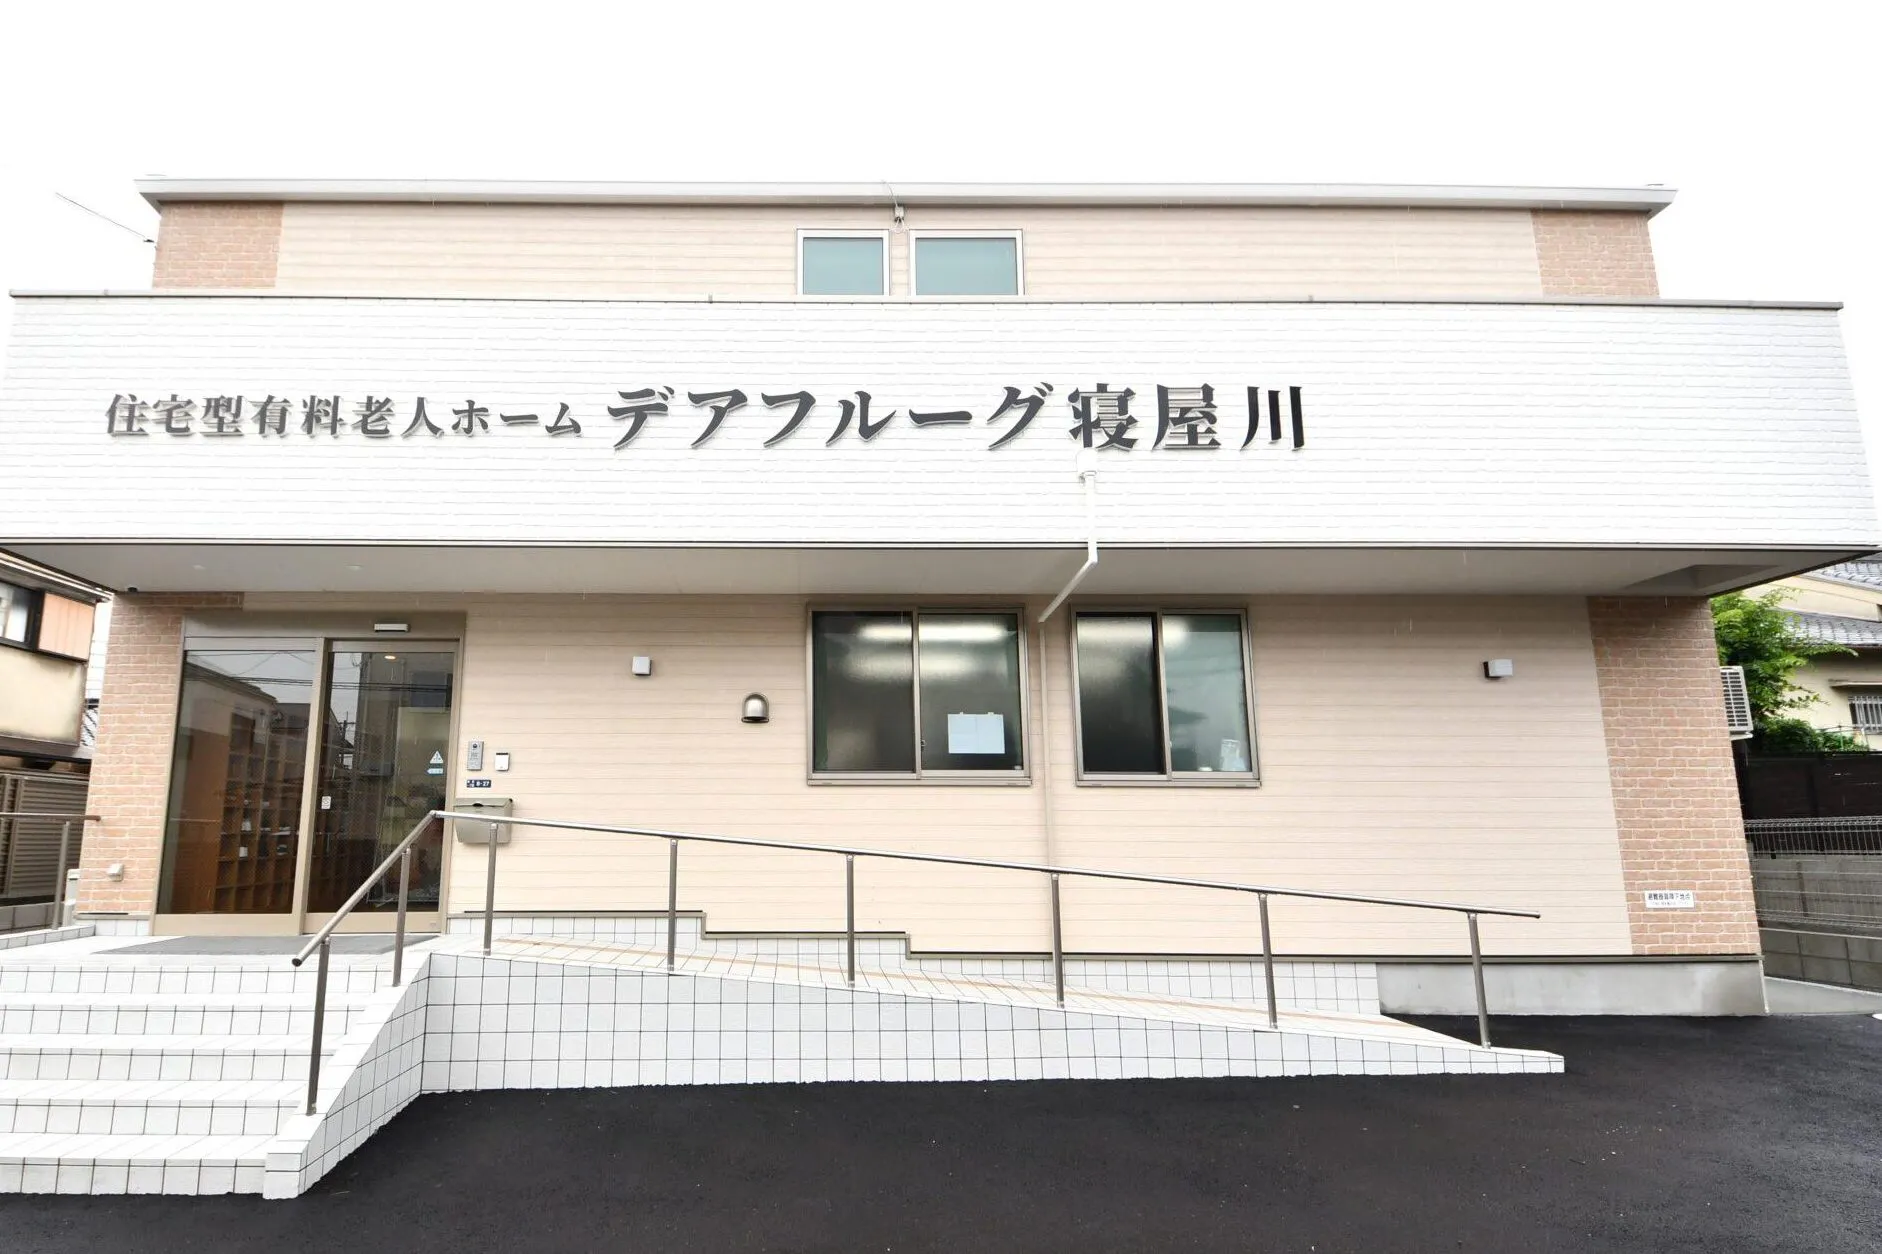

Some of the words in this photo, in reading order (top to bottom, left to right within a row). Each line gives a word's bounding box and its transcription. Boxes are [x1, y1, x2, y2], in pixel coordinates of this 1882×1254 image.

[106, 393, 582, 438] 住宅型有料老人ホーム
[608, 383, 1304, 452] デアフルーグ寝屋川
